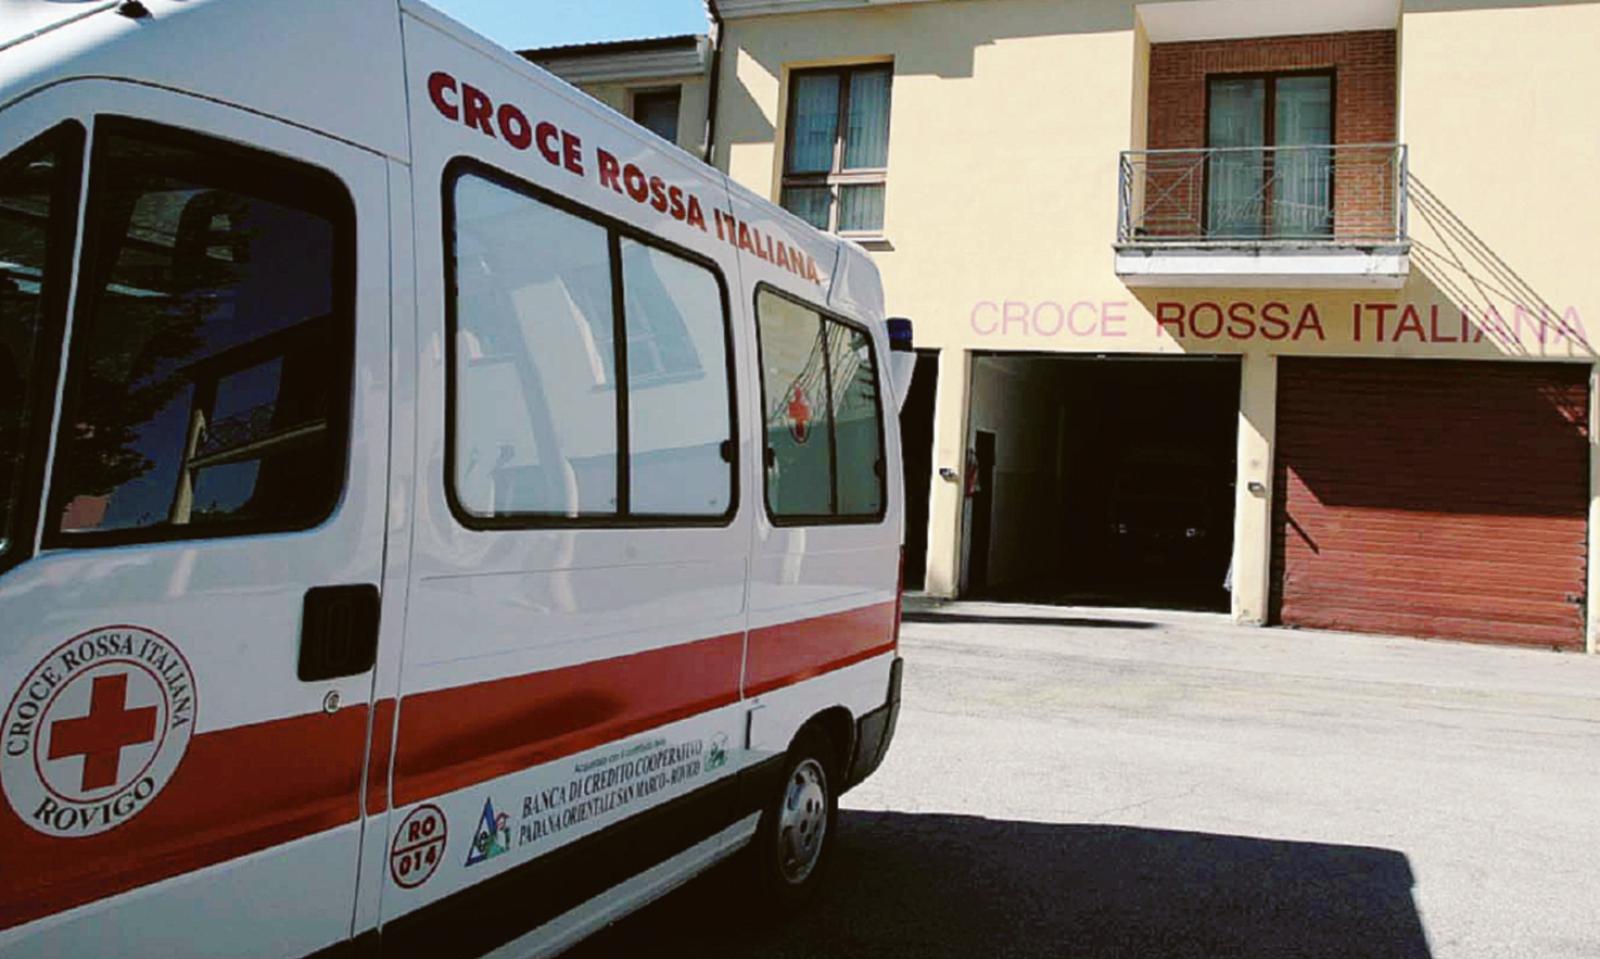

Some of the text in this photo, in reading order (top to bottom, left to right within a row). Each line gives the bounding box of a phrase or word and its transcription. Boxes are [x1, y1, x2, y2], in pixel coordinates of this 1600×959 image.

[427, 71, 820, 285] CROCE ROSSA ITALIANA
[970, 300, 1589, 346] CROCE ROSSA ITALIANA
[6, 634, 191, 757] CROCE ROSSA ITALIANA
[33, 776, 155, 831] ROVIGO
[522, 786, 566, 819] BANCA
[569, 779, 583, 801] DI
[584, 762, 634, 796] CREDITO
[408, 815, 436, 842] RO
[399, 845, 437, 876] 014
